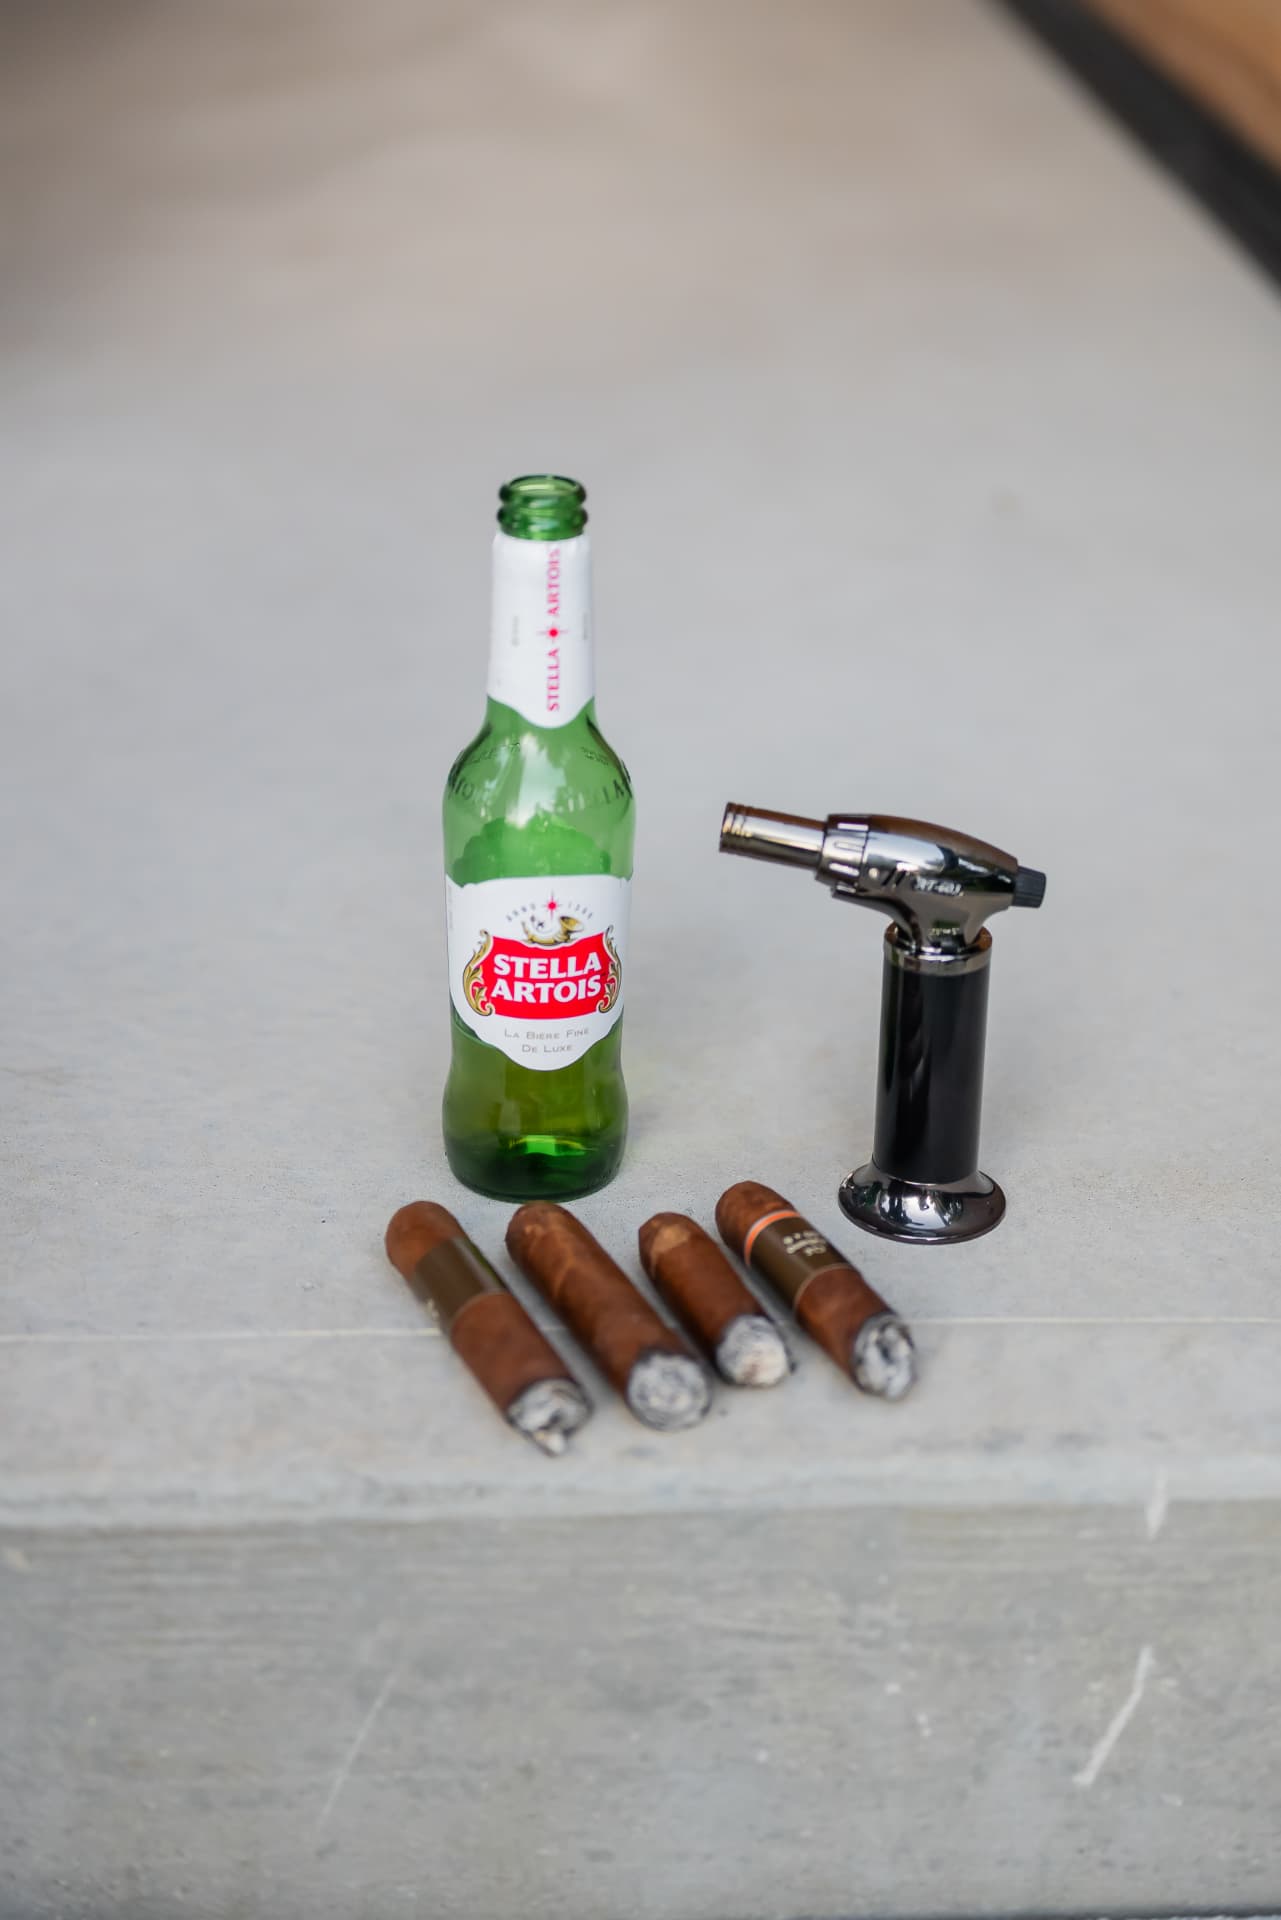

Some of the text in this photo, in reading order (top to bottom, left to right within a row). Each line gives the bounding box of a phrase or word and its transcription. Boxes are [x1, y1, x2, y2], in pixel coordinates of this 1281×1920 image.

[547, 548, 560, 712] STELLA ARTOIS
[493, 951, 602, 980] STELLA
[491, 974, 602, 1004] ARTOIS
